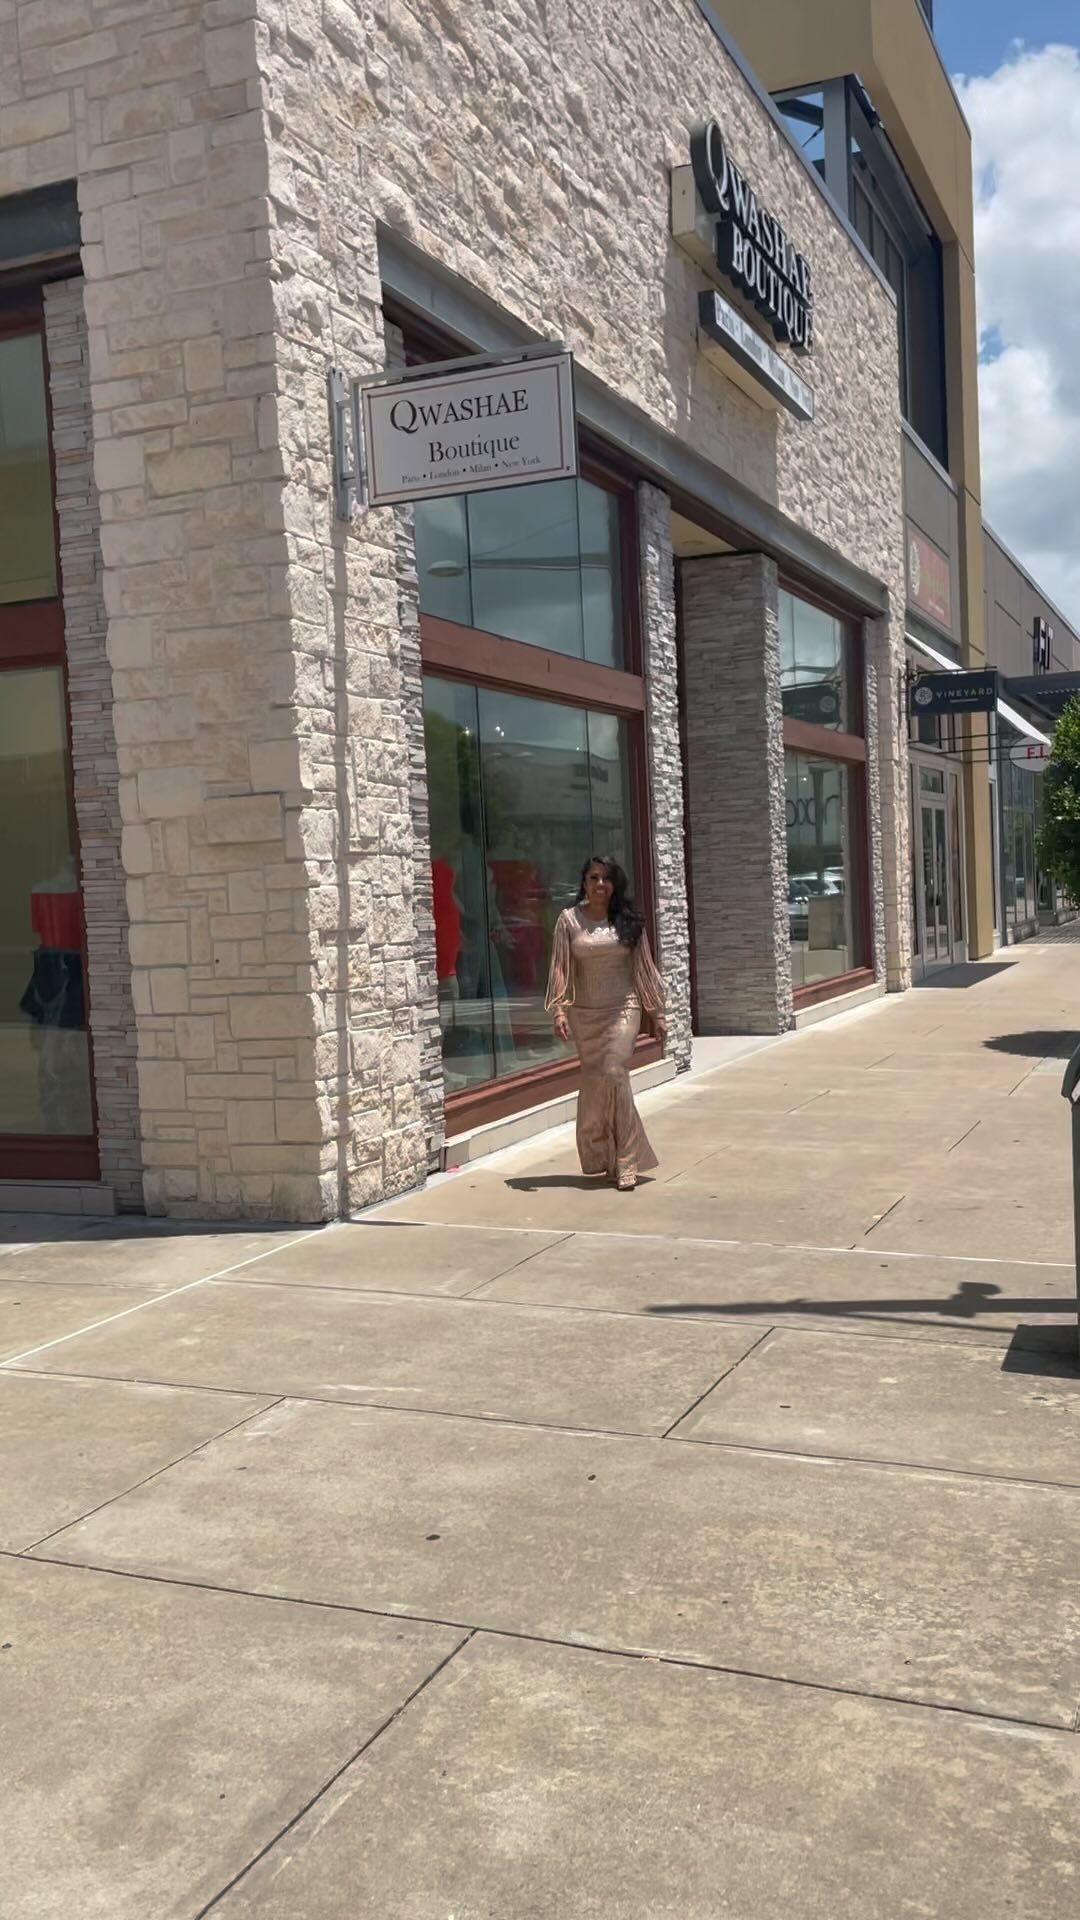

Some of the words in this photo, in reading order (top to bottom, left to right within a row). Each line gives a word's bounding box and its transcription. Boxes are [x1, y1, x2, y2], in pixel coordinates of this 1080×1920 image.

[732, 221, 812, 353] BOUTIQUE
[428, 434, 521, 463] Boutique
[401, 474, 421, 484] Paris
[429, 468, 461, 480] London
[468, 464, 492, 474] Milan
[501, 459, 519, 469] New
[521, 455, 542, 467] York
[935, 686, 993, 699] VINEYARD
